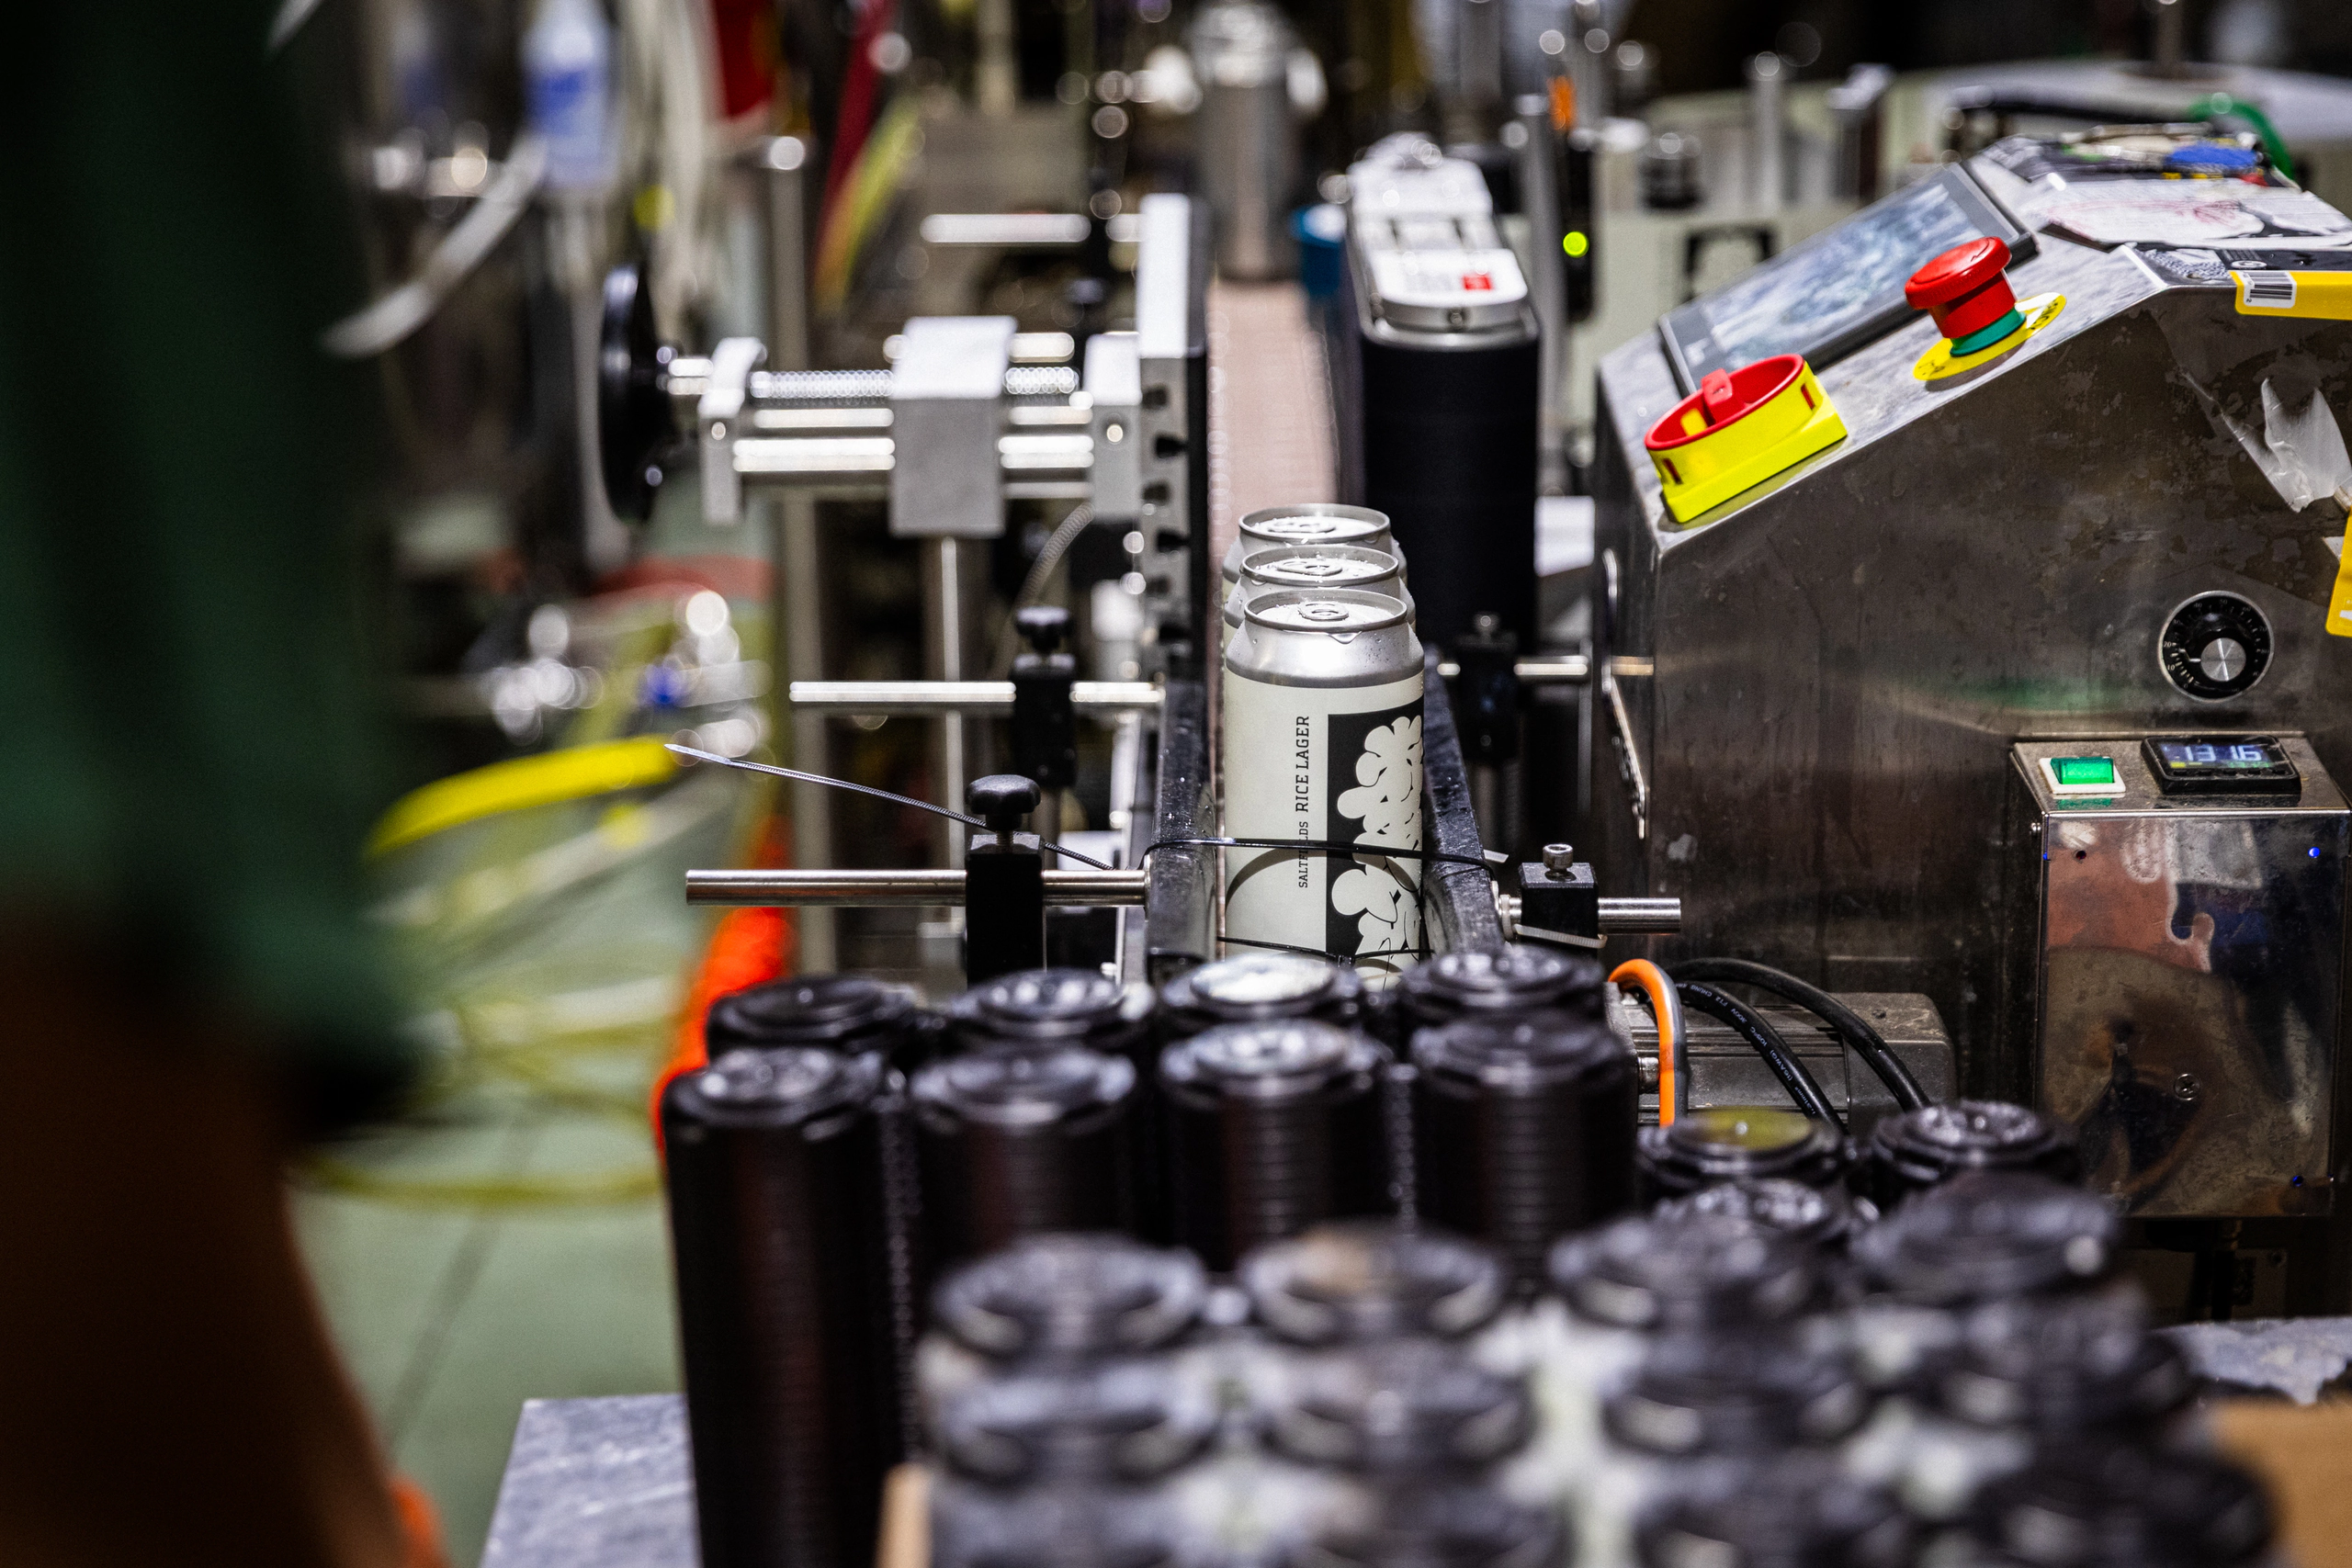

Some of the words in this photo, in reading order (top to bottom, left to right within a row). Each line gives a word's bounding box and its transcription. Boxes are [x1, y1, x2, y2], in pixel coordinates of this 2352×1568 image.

[1295, 716, 1310, 769] LAGER
[1295, 774, 1309, 813] RICE
[1298, 820, 1309, 888] SALTFILDS
[1690, 984, 1713, 998] CHUNG
[1730, 1008, 1747, 1023] 300V
